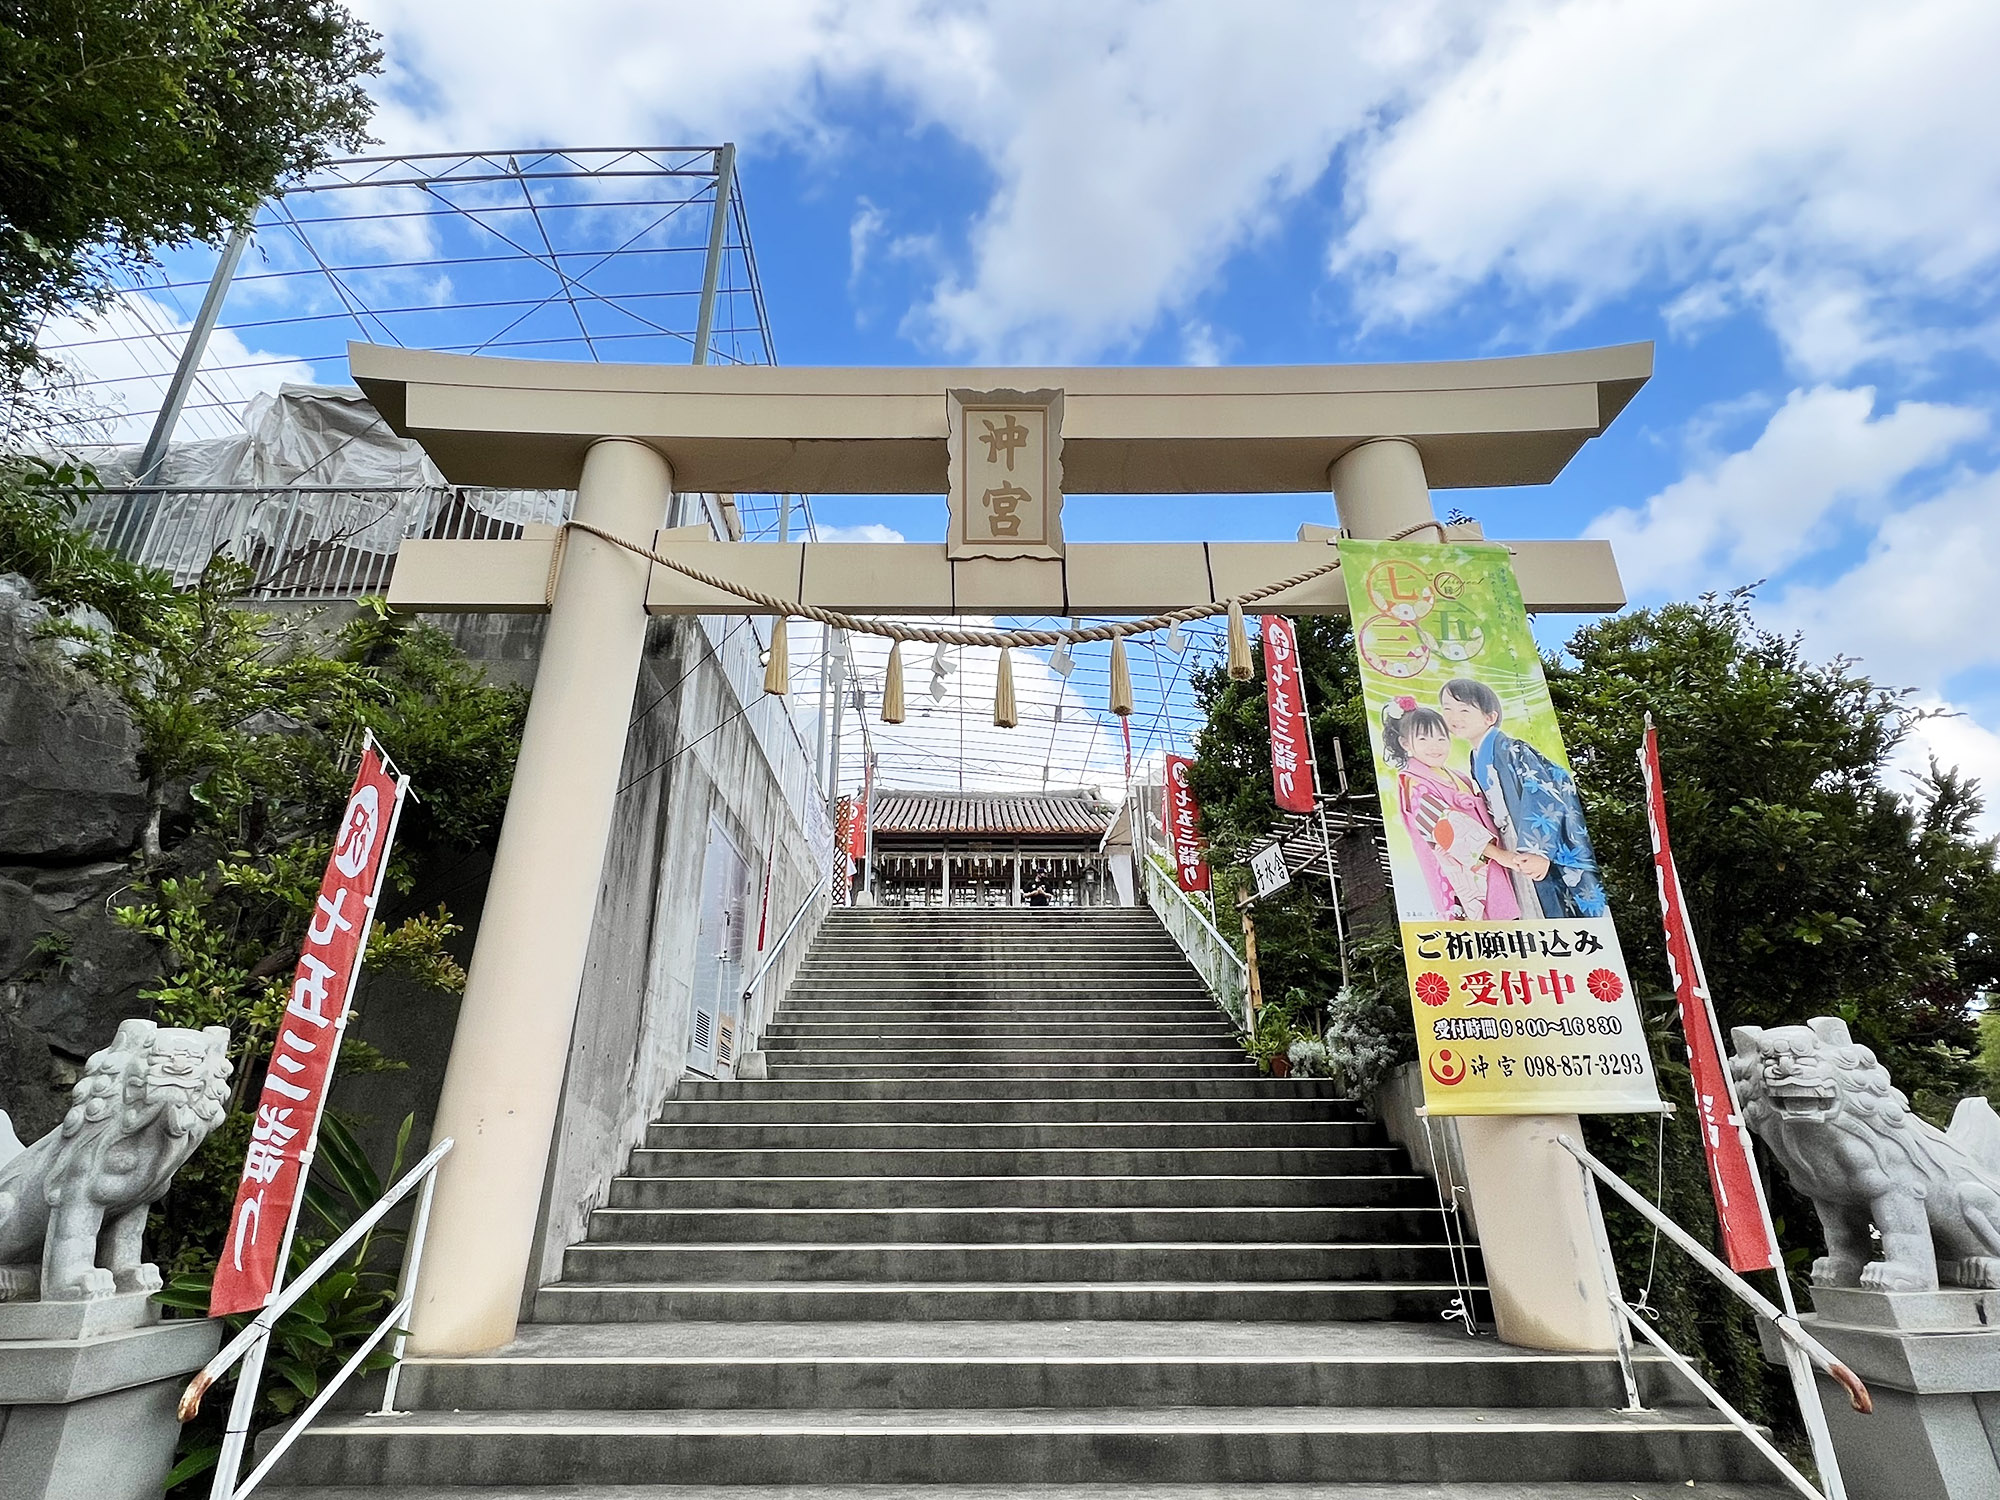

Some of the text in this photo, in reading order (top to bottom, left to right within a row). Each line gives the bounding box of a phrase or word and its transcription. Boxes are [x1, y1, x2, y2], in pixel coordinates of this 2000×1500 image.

[1416, 928, 1604, 960] ご祈願申込み
[1460, 968, 1576, 1006] 受付中
[1433, 1017, 1498, 1040] 受付時間
[1524, 1053, 1644, 1078] 098-857-3293
